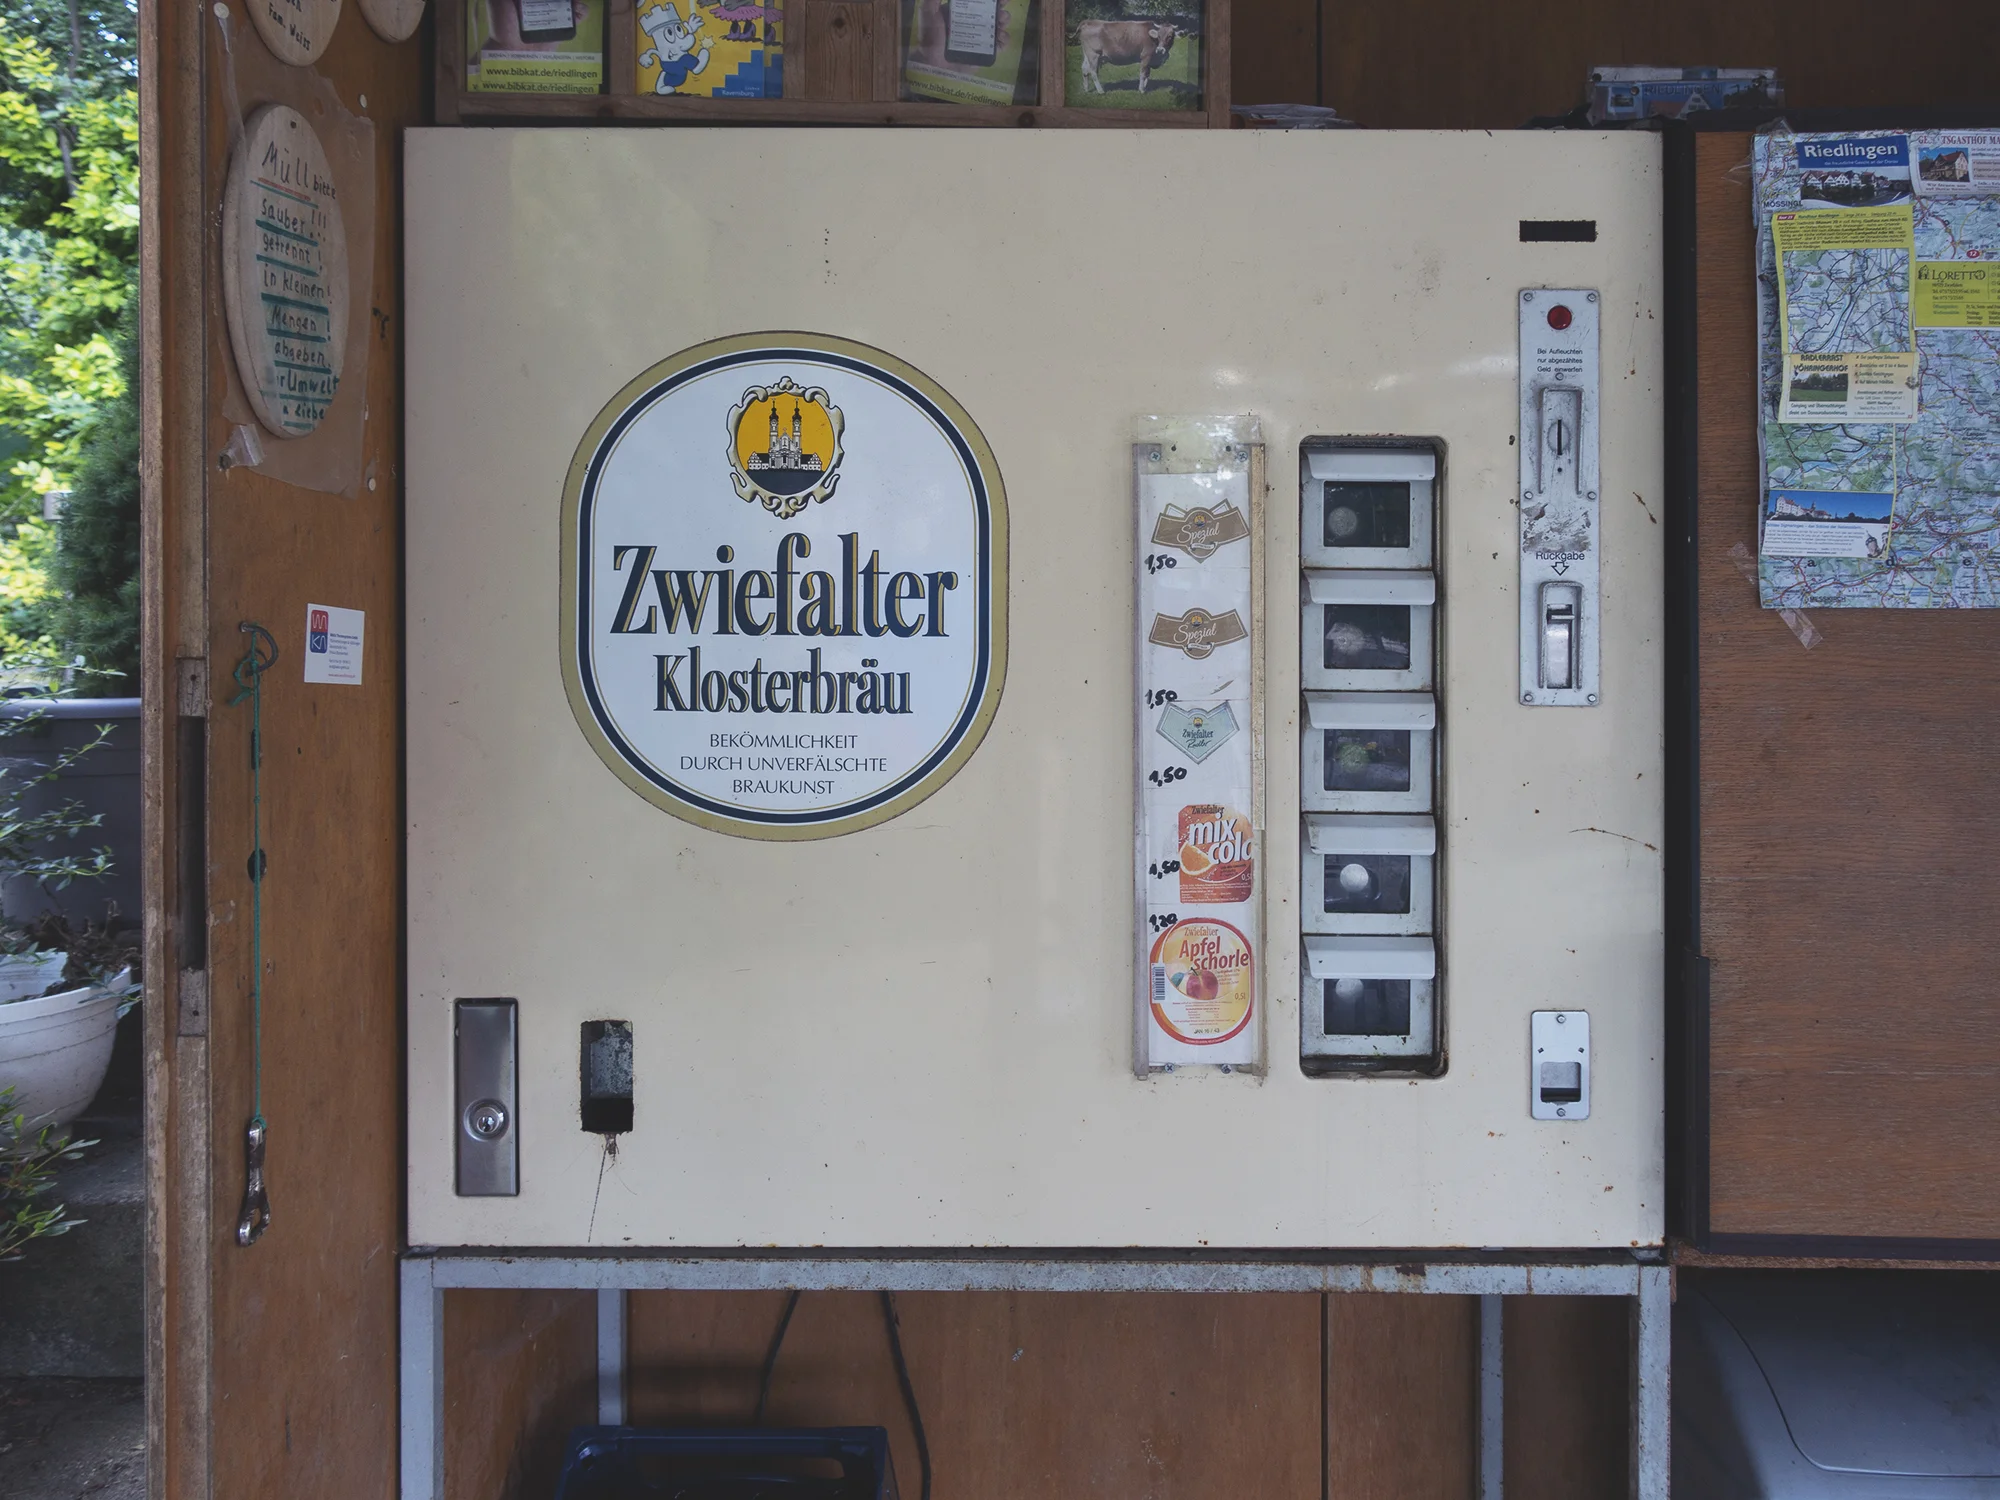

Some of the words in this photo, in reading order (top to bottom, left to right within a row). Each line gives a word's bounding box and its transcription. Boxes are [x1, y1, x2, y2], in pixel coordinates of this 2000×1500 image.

[486, 68, 598, 79] www.bibkat.de/riedlingen
[1803, 143, 1898, 159] Riedlingen
[313, 174, 336, 200] bitte
[264, 263, 277, 287] in
[1932, 269, 1986, 280] LORETTO
[1176, 522, 1220, 544] Spezial
[1144, 554, 1177, 575] 1,50
[609, 532, 959, 638] Zwiefalter
[1173, 622, 1217, 644] Spezial
[653, 645, 914, 715] Klosterbräu
[1144, 689, 1178, 709] 1,50
[709, 731, 858, 749] BEKÖMMLICHKEIT
[1182, 728, 1214, 739] Zwiefalter
[680, 756, 742, 771] DURCH
[748, 754, 888, 772] UNVERFÄLSCHTE
[733, 779, 835, 794] BRAUKUNST
[1149, 766, 1187, 787] 1,50
[1189, 812, 1238, 846] mix
[1184, 926, 1219, 937] Zwiefalter
[1179, 936, 1221, 961] Apfel
[1192, 949, 1249, 971] schorle
